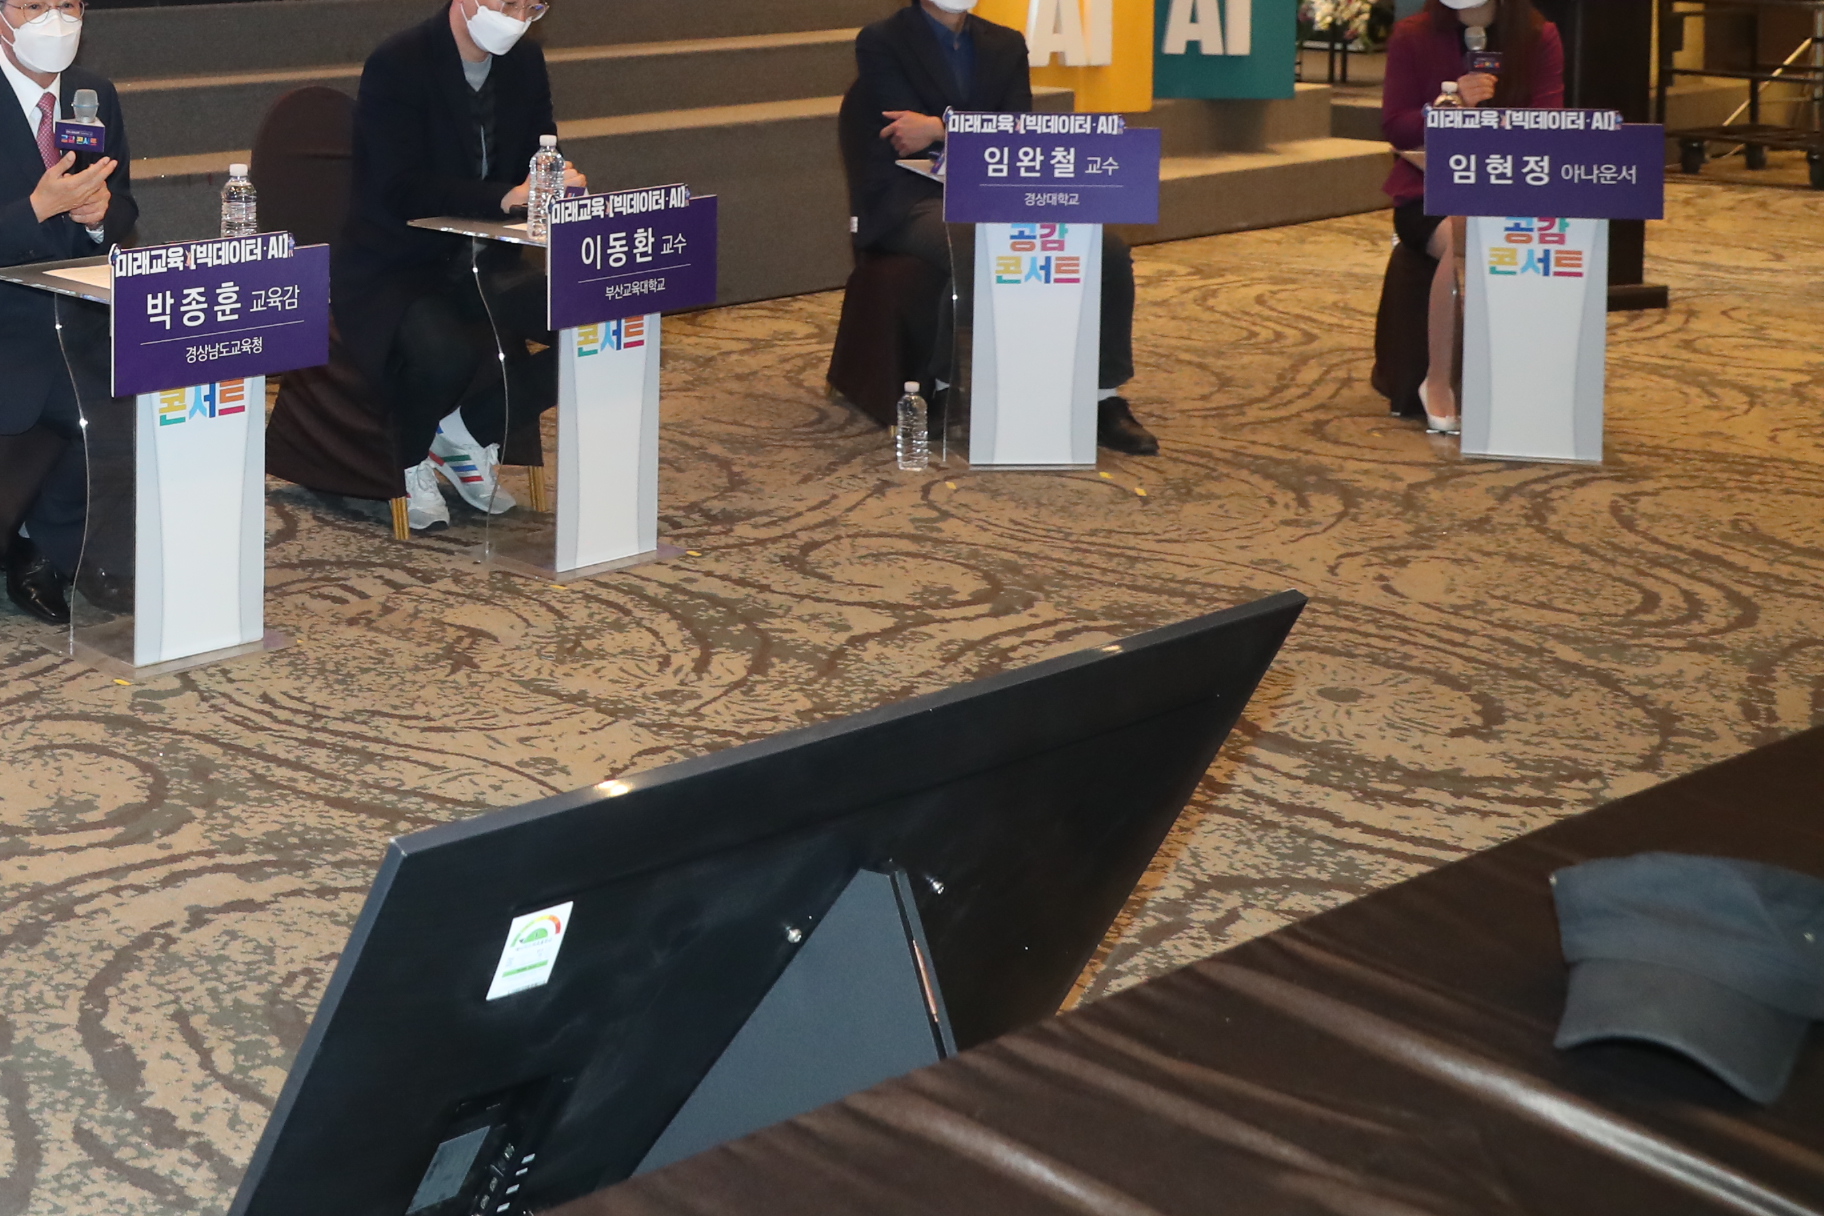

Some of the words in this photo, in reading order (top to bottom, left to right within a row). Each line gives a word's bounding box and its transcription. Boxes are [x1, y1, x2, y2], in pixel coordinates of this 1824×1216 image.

[948, 114, 1014, 133] 미래교육
[1426, 110, 1499, 129] 미래교육
[1085, 157, 1120, 176] 교수
[1561, 164, 1637, 184] 아나운서
[551, 197, 605, 224] 미래교육
[1024, 193, 1080, 206] 경상대학교
[660, 233, 687, 254] 교수
[1009, 223, 1068, 252] 공감
[1504, 217, 1570, 245] 공감
[115, 247, 184, 277] 미래교육
[995, 256, 1080, 284] 콘서트
[1488, 247, 1584, 277] 콘서트
[249, 285, 300, 312] 교육감
[605, 278, 665, 300] 부산교육대학교
[577, 315, 644, 357] 콘서트
[185, 336, 263, 364] 경상남도교육청
[159, 378, 245, 426] 콘서트
